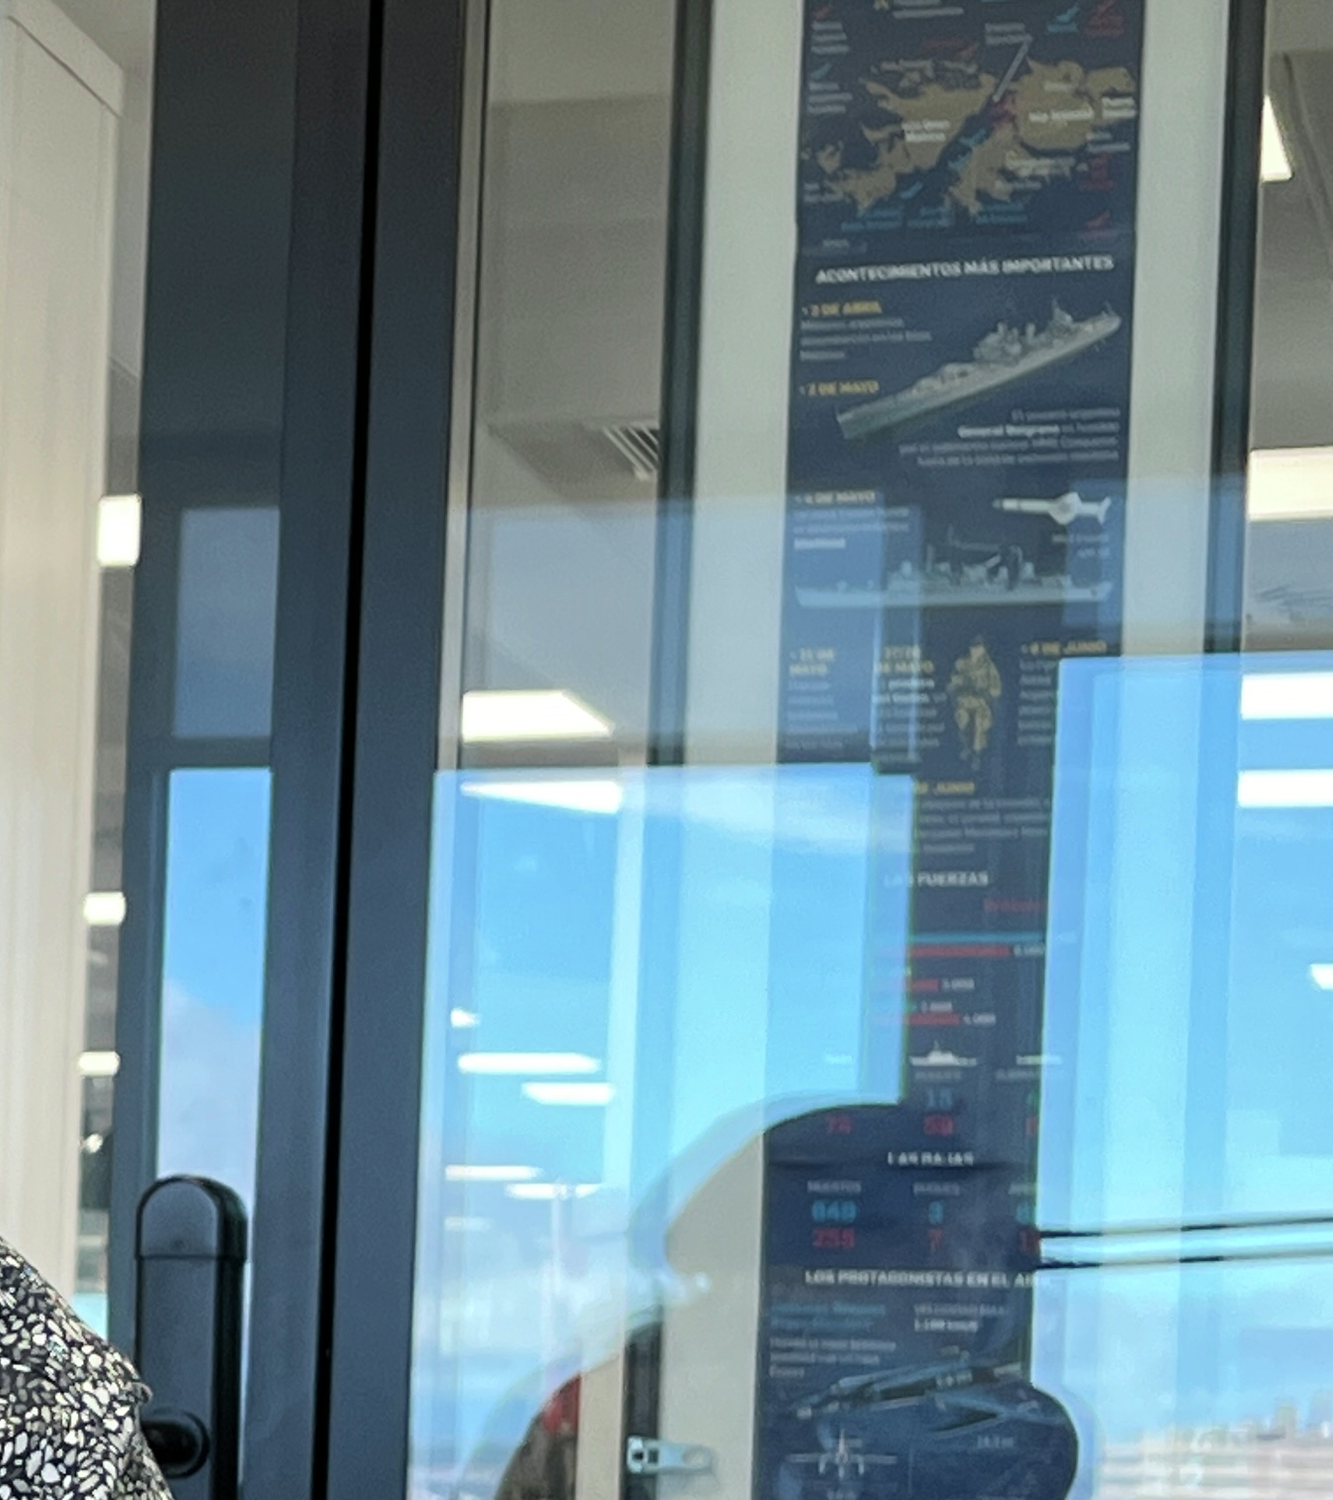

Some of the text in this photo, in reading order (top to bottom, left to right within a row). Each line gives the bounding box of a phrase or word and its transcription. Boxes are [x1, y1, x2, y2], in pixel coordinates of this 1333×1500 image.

[1002, 254, 1114, 273] IMPORTANTES
[917, 871, 990, 887] FUERZAS
[838, 1269, 964, 1286] PROTAGONISTAS
[966, 1271, 989, 1286] EN
